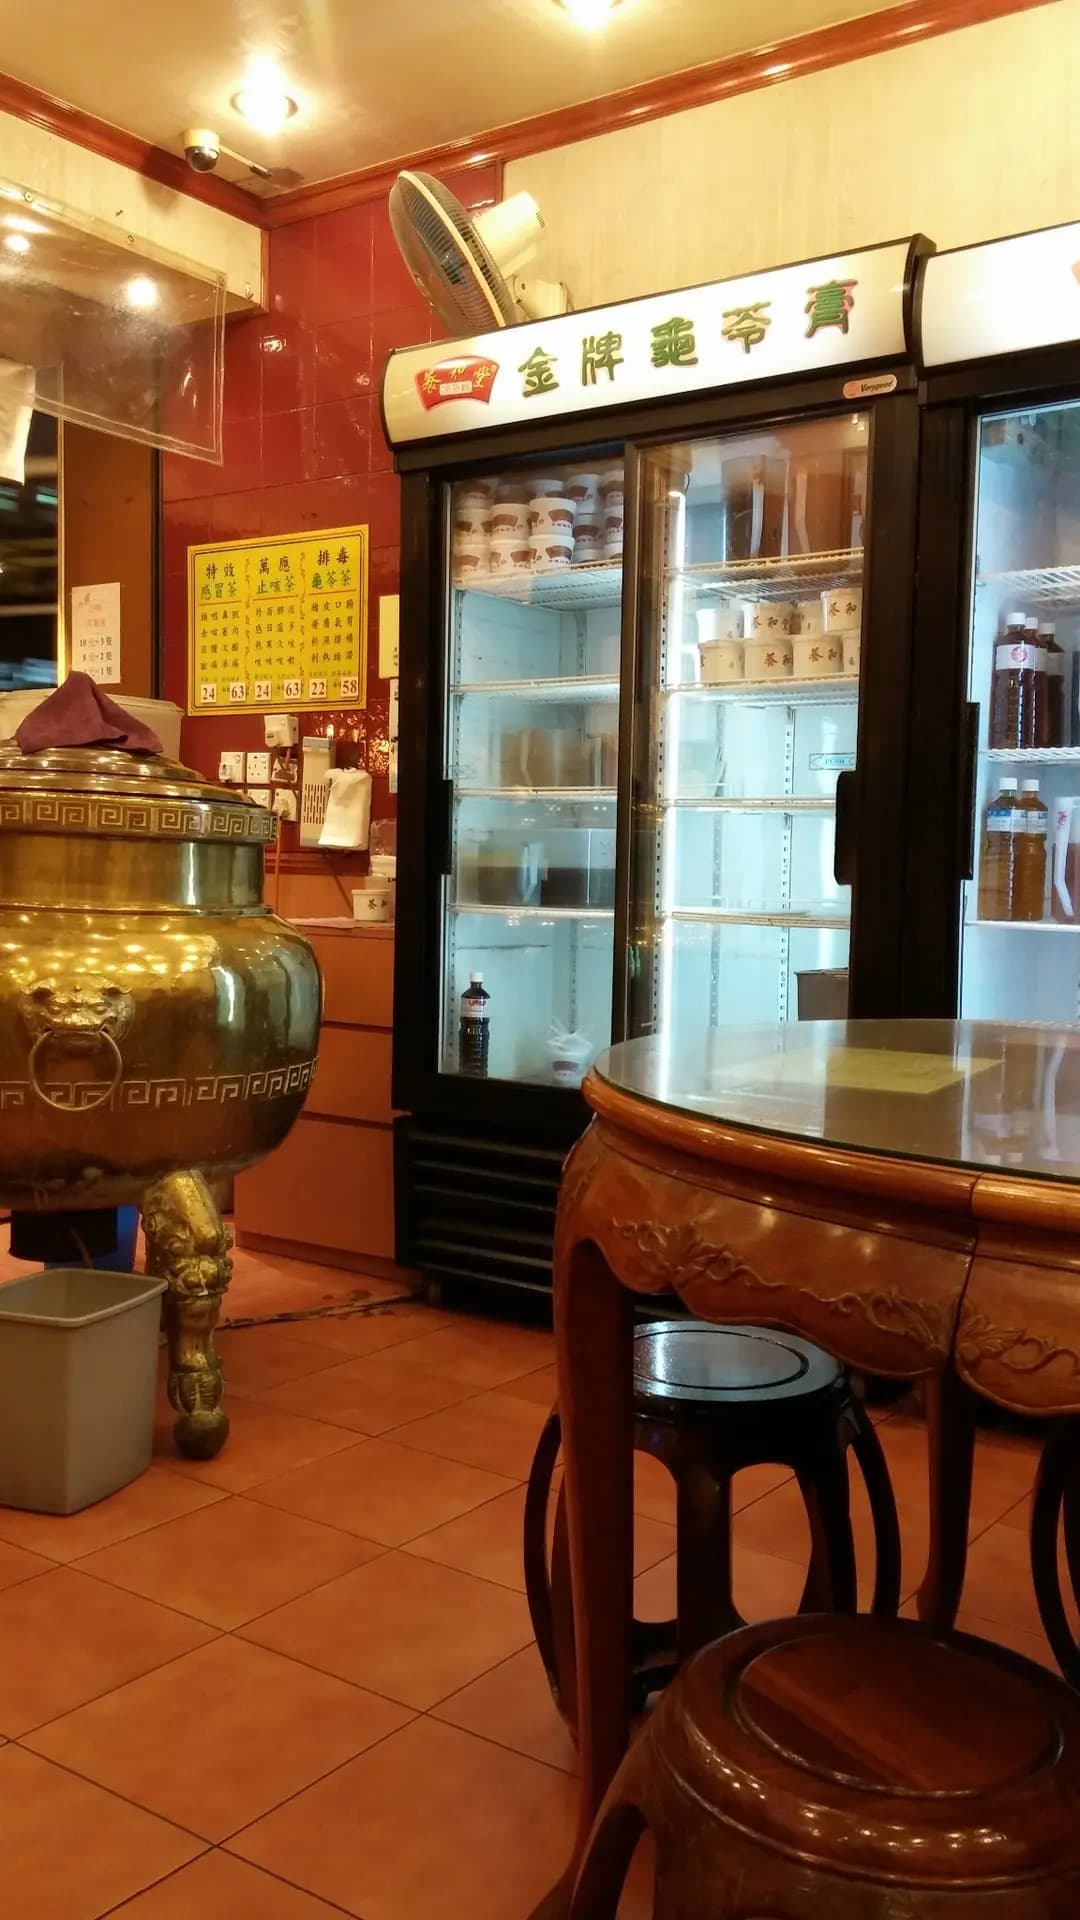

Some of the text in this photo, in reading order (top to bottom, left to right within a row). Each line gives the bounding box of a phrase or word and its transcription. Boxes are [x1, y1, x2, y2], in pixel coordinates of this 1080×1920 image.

[317, 547, 350, 566] 排毒
[258, 556, 291, 575] 萬應
[202, 687, 215, 700] 24
[231, 685, 244, 698] 63
[256, 684, 270, 698] 24
[286, 682, 299, 696] 63
[311, 681, 325, 695] 22
[342, 680, 357, 694] 58
